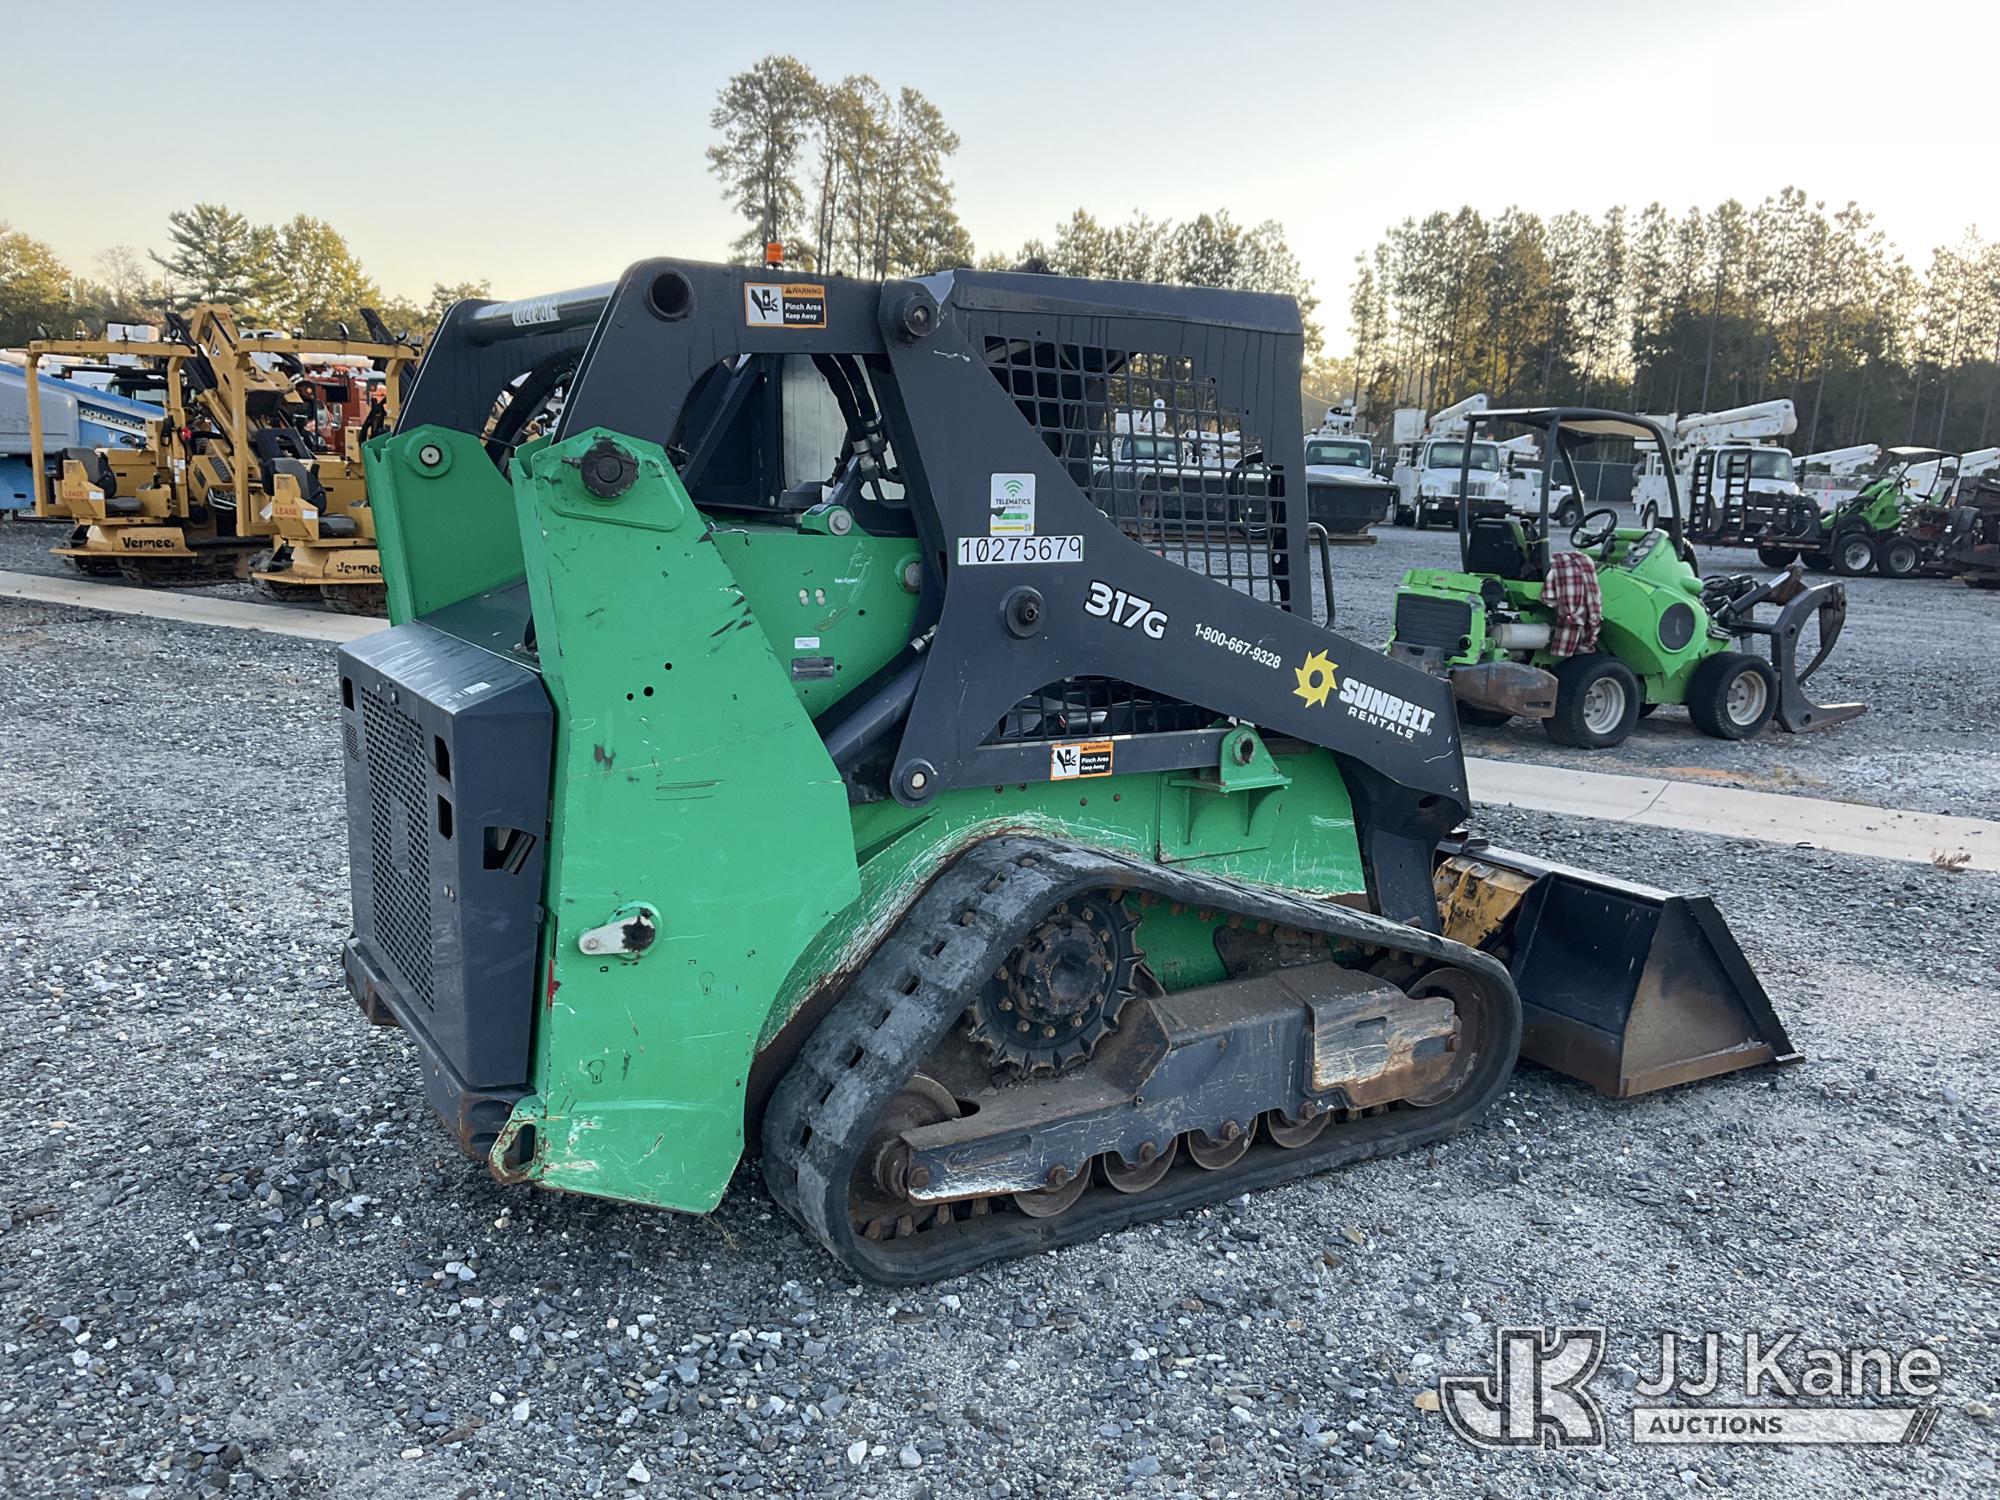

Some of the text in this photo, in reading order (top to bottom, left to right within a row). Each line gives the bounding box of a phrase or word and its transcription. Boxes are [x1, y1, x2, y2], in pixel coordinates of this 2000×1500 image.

[792, 286, 822, 295] WARNING
[785, 303, 822, 311] Pinch Area
[785, 312, 817, 321] Keep Away
[64, 490, 85, 498] LEASE
[275, 507, 297, 516] LEASE
[962, 537, 1081, 562] 10275679
[1084, 581, 1168, 639] 317G
[1195, 623, 1281, 669] 1-800-667-9328
[1339, 677, 1436, 733] SUNBELT
[1347, 706, 1414, 740] RENTALS
